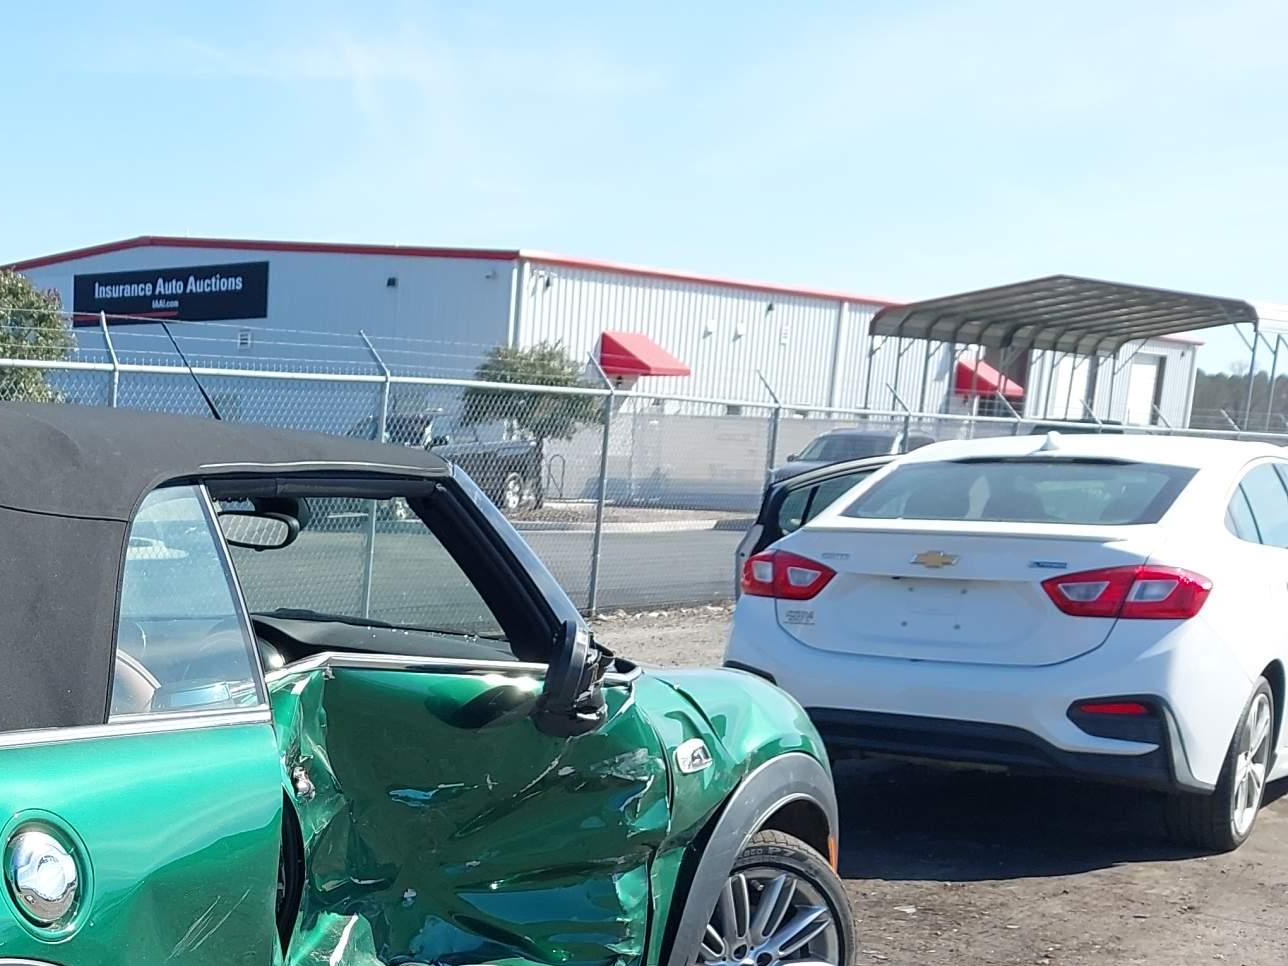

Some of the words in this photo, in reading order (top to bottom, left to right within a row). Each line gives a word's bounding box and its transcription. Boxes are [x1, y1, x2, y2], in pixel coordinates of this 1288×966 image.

[94, 281, 153, 298] Insurance
[155, 277, 184, 295] Auto
[185, 273, 243, 293] Auctions
